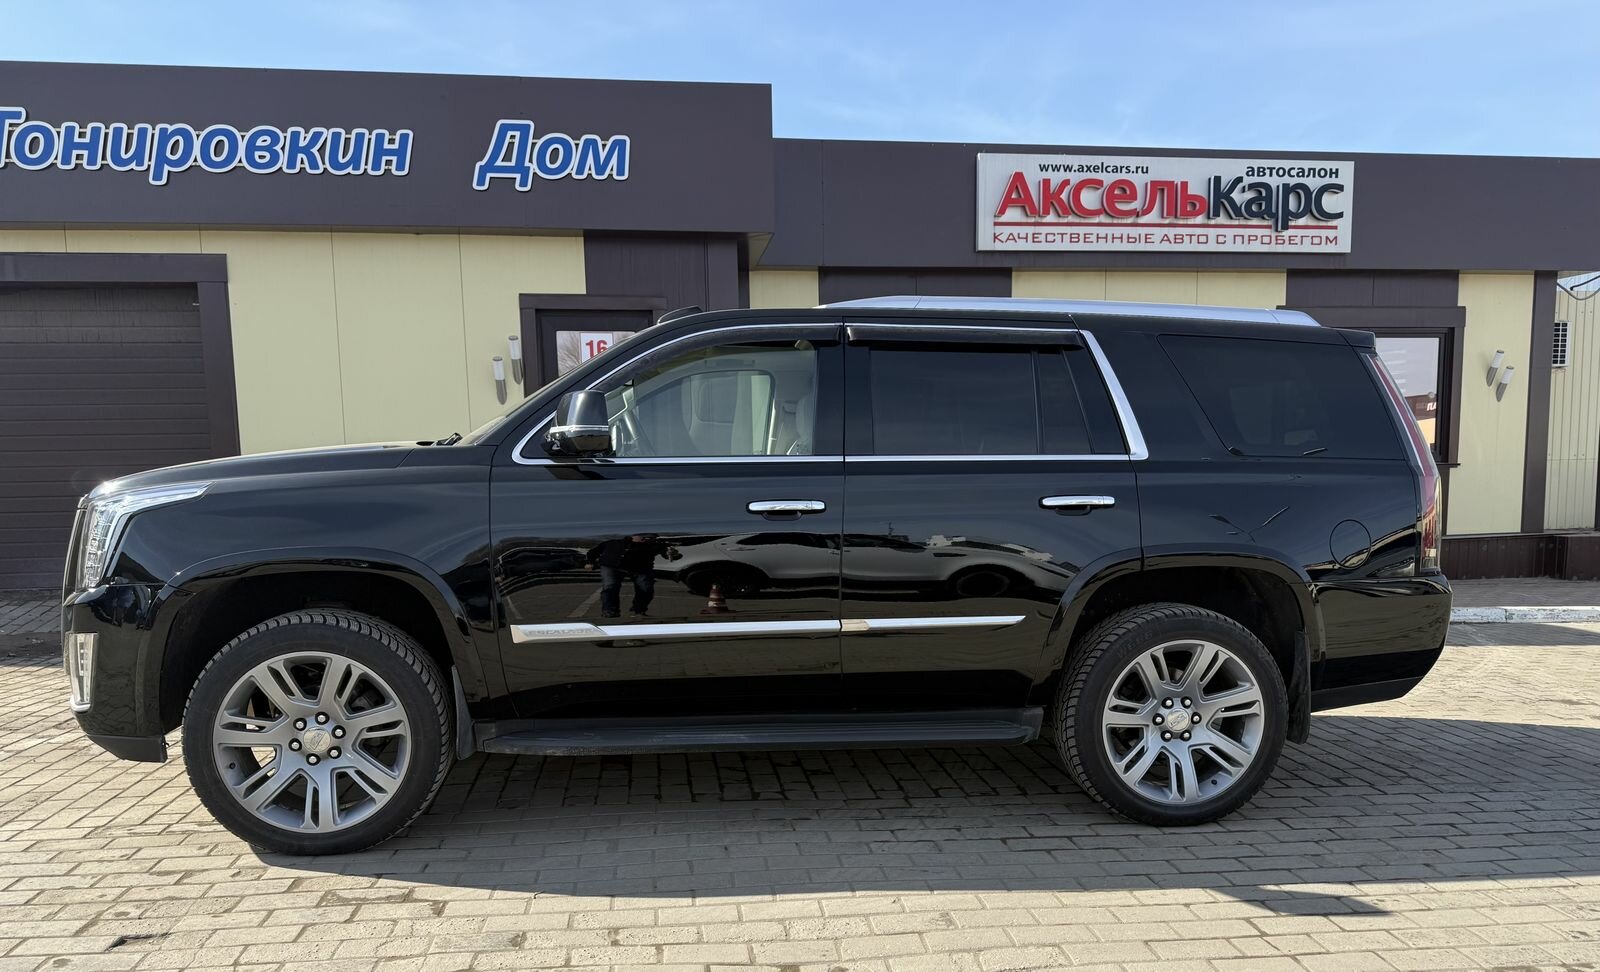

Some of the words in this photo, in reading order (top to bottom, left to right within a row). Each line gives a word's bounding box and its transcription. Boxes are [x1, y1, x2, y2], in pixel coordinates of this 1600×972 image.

[472, 119, 630, 191] Дом
[1039, 162, 1149, 174] www.axelcars.ru
[1245, 166, 1339, 179] автосалон
[993, 232, 1155, 244] КАЧЕСТВЕННЫЕ
[1160, 233, 1209, 245] АВТО
[1216, 234, 1227, 245] С
[1233, 234, 1338, 246] ПРОБЕГОМ
[586, 340, 608, 358] 16
